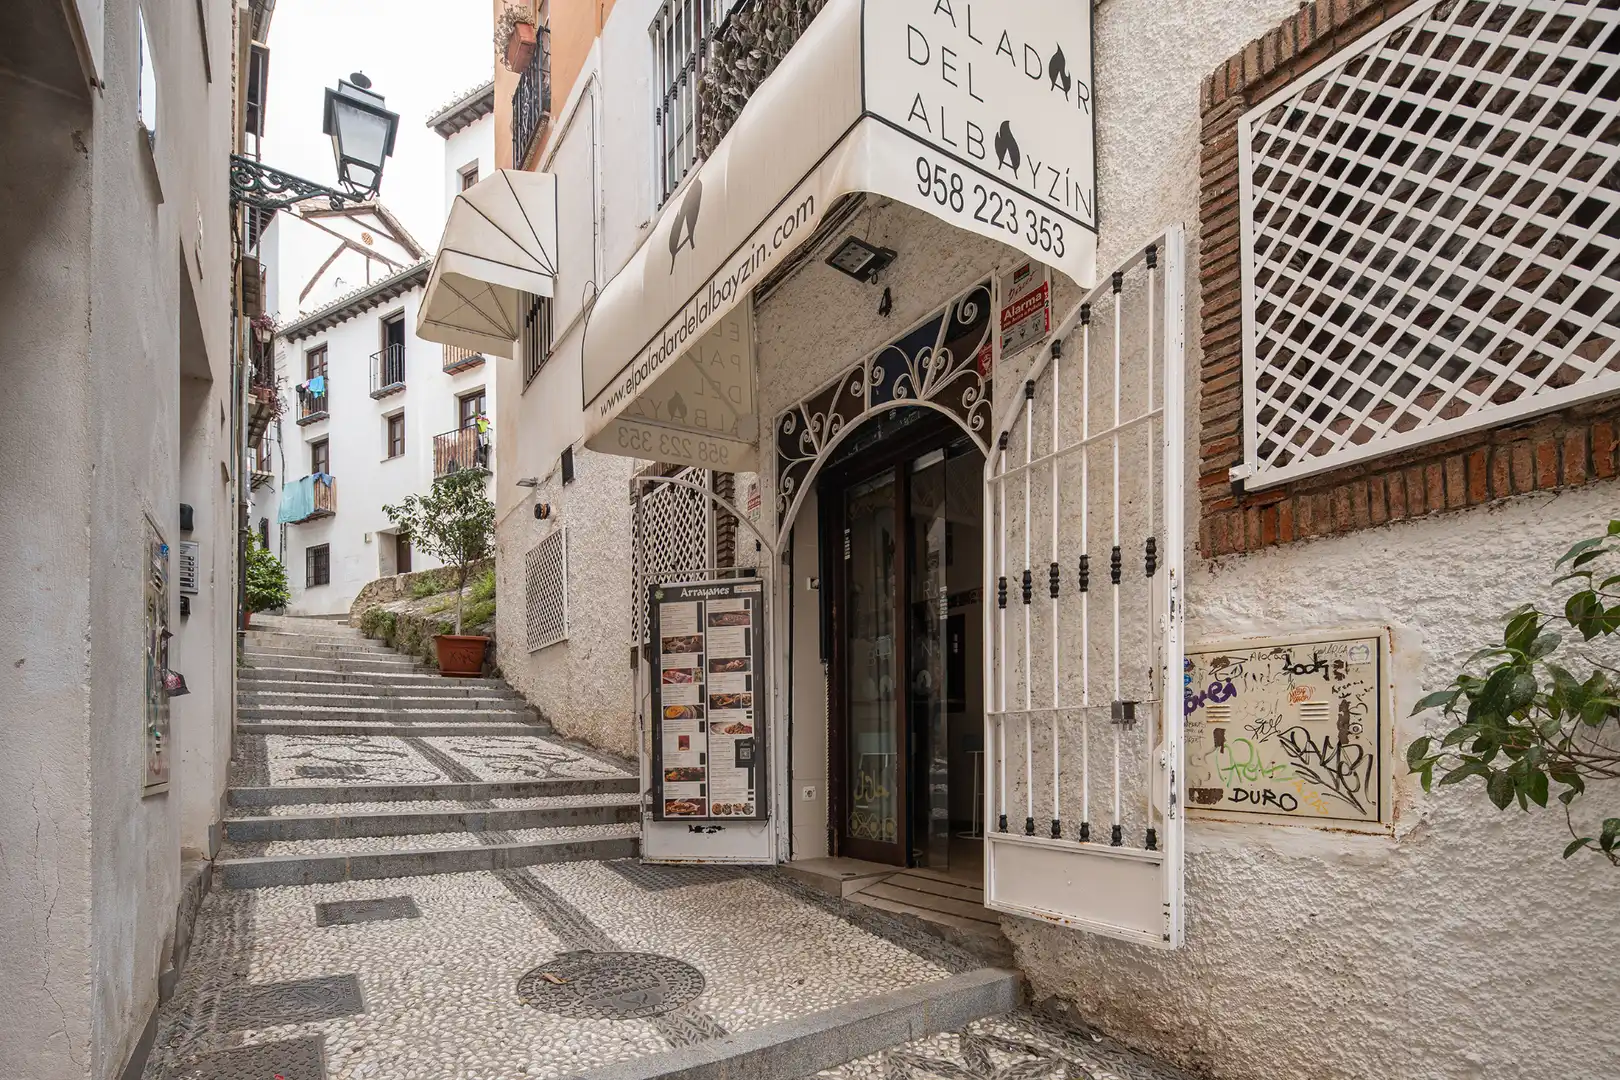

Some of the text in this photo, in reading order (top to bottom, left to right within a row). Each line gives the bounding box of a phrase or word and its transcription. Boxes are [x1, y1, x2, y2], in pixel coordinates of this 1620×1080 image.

[907, 23, 984, 103] DEL
[907, 92, 1092, 219] ALBAYZÍN
[915, 156, 1066, 259] 958 223 353
[599, 194, 815, 418] www.elpaladardelalbayzin.com
[1003, 292, 1042, 321] Alarma
[680, 587, 730, 599] Arrayanes
[1228, 787, 1298, 812] DURO
